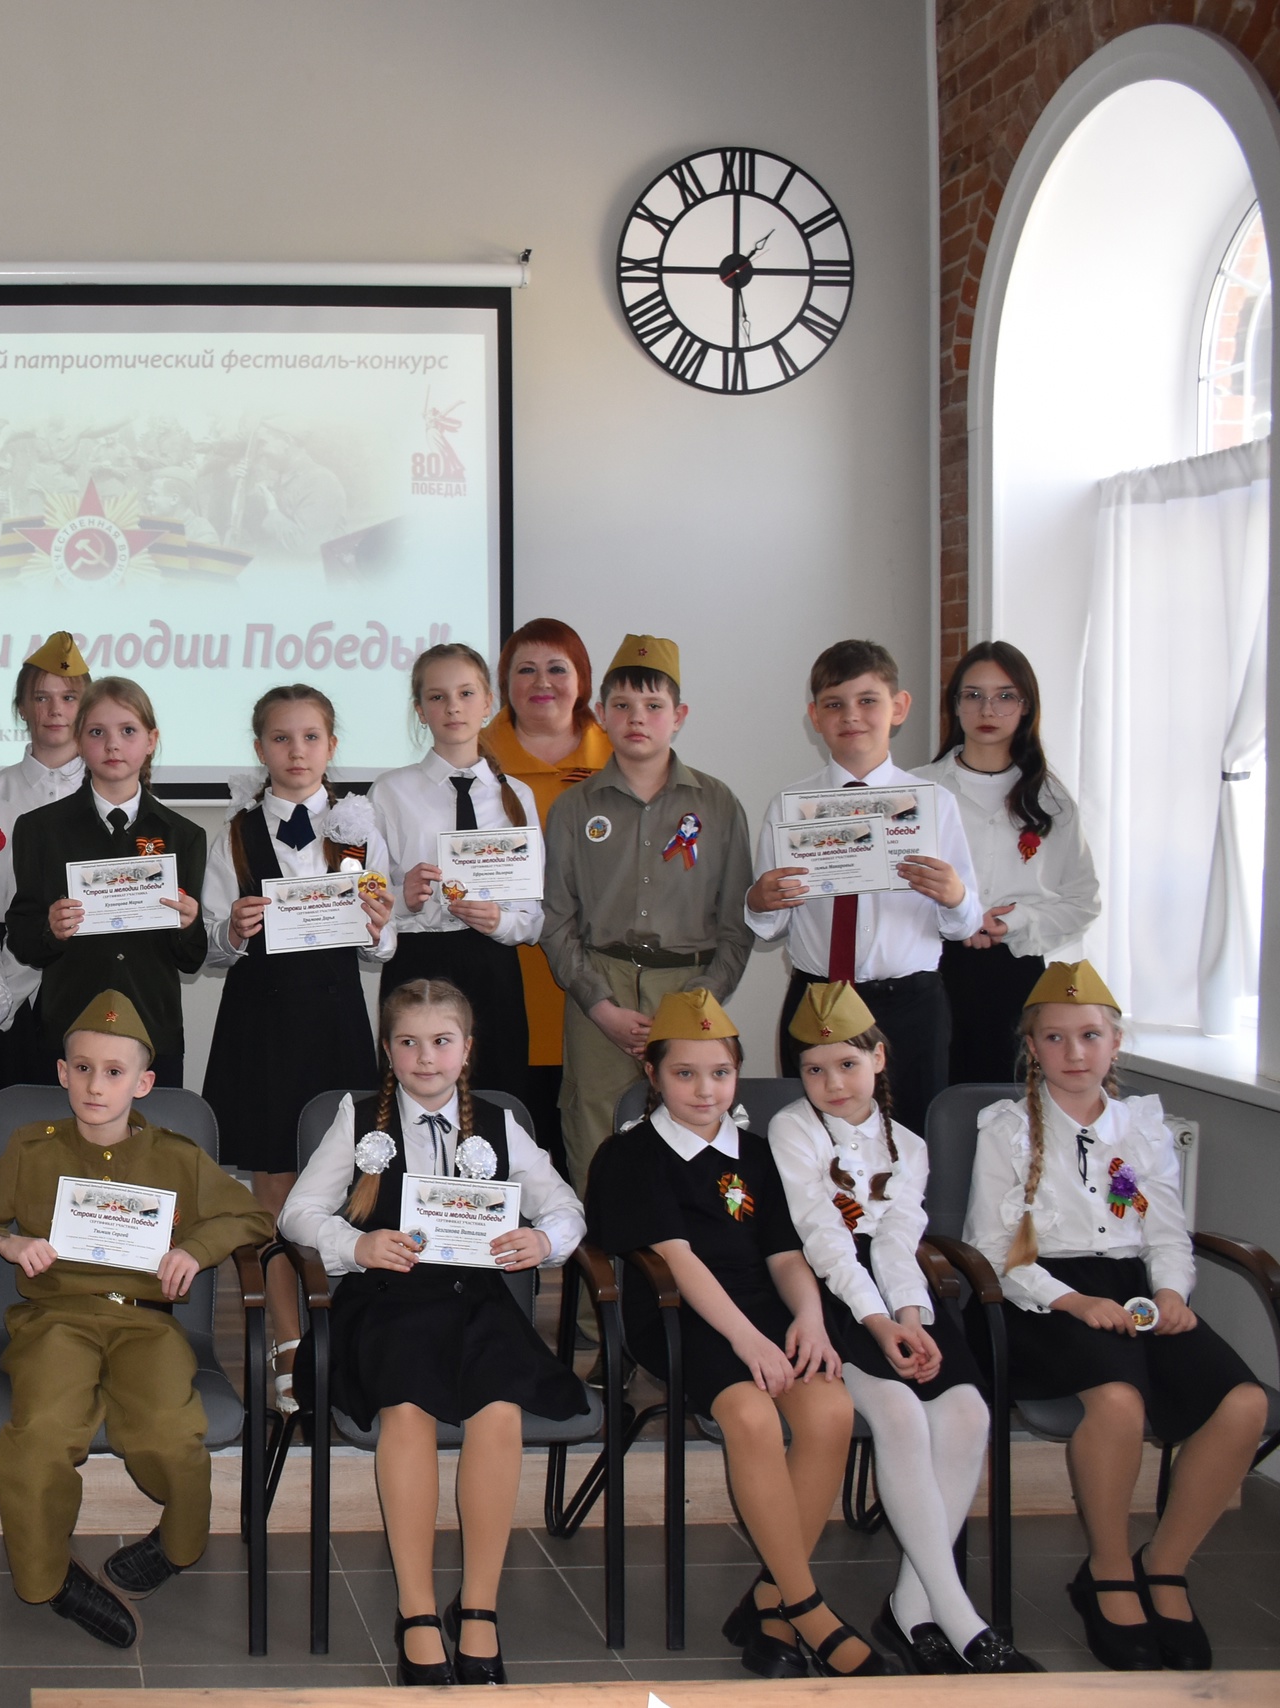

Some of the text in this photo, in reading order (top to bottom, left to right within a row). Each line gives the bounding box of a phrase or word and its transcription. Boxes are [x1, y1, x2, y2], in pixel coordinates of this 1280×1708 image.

[668, 162, 706, 209] XI
[720, 151, 755, 190] XII
[776, 167, 796, 203] I
[633, 203, 674, 236] X
[799, 207, 840, 240] II
[621, 257, 659, 283] IX
[813, 260, 851, 287] III
[626, 290, 679, 349] VIII
[799, 303, 841, 345] IV
[14, 350, 214, 374] патриотический
[221, 349, 449, 374] фестиваль-конкурс
[665, 330, 709, 382] VII
[722, 352, 748, 390] VI
[772, 341, 800, 379] V
[411, 453, 441, 478] 80
[411, 481, 467, 498] ПОБЕДА!
[417, 1208, 443, 1218] "Строки
[450, 1212, 477, 1220] мелодии
[478, 1213, 505, 1222] Победы"
